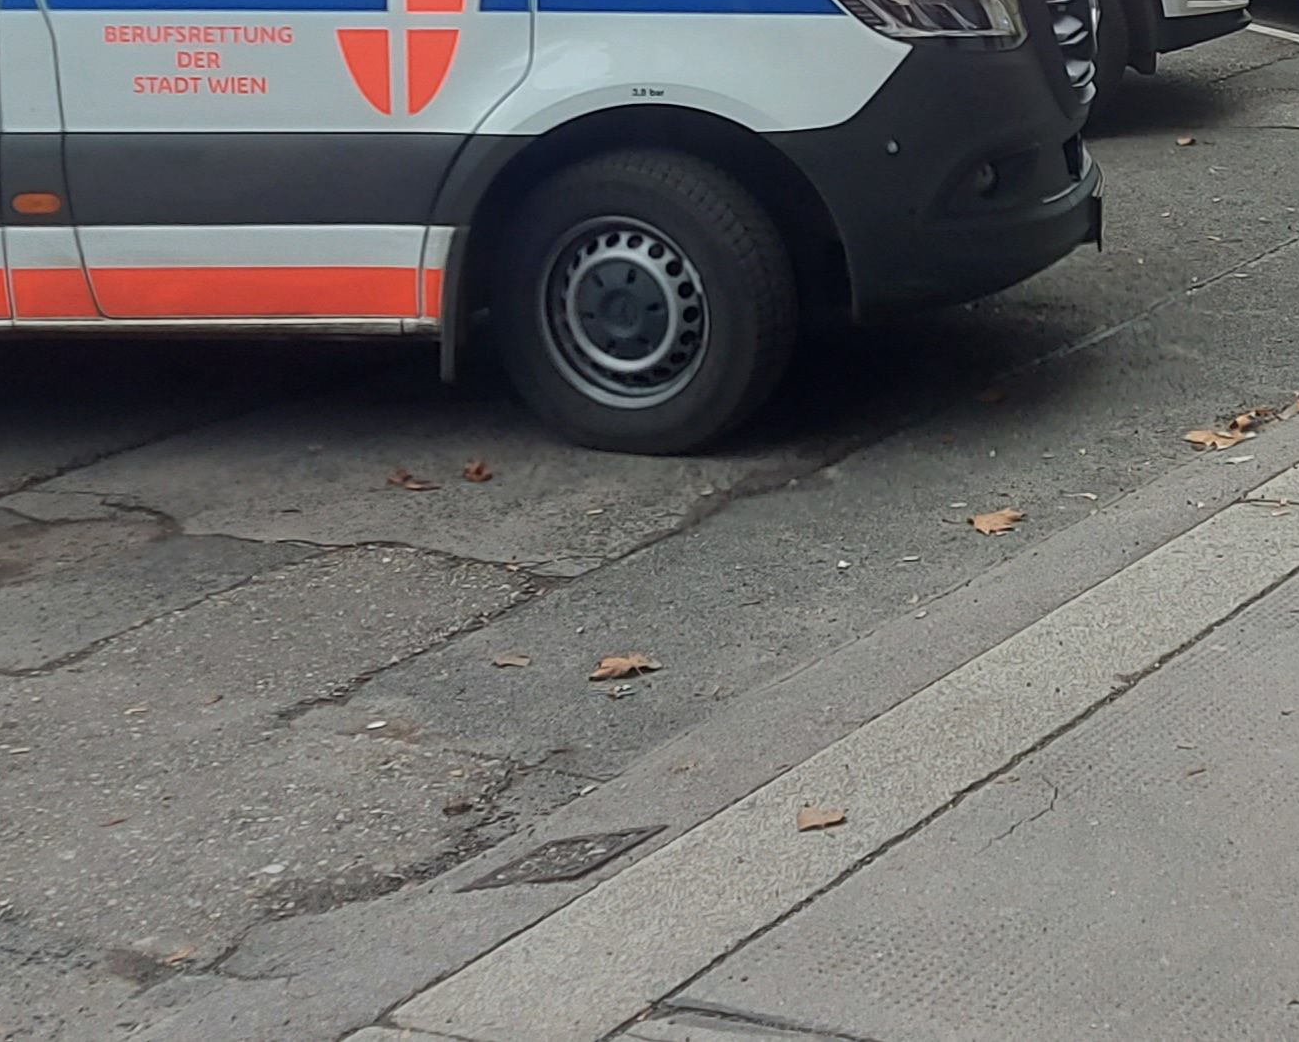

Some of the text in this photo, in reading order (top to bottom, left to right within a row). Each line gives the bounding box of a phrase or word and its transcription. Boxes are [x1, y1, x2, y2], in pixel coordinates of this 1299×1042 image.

[103, 25, 294, 44] BERUFSRETTUNG
[176, 51, 221, 69] DER
[132, 76, 268, 95] STADT WIEN
